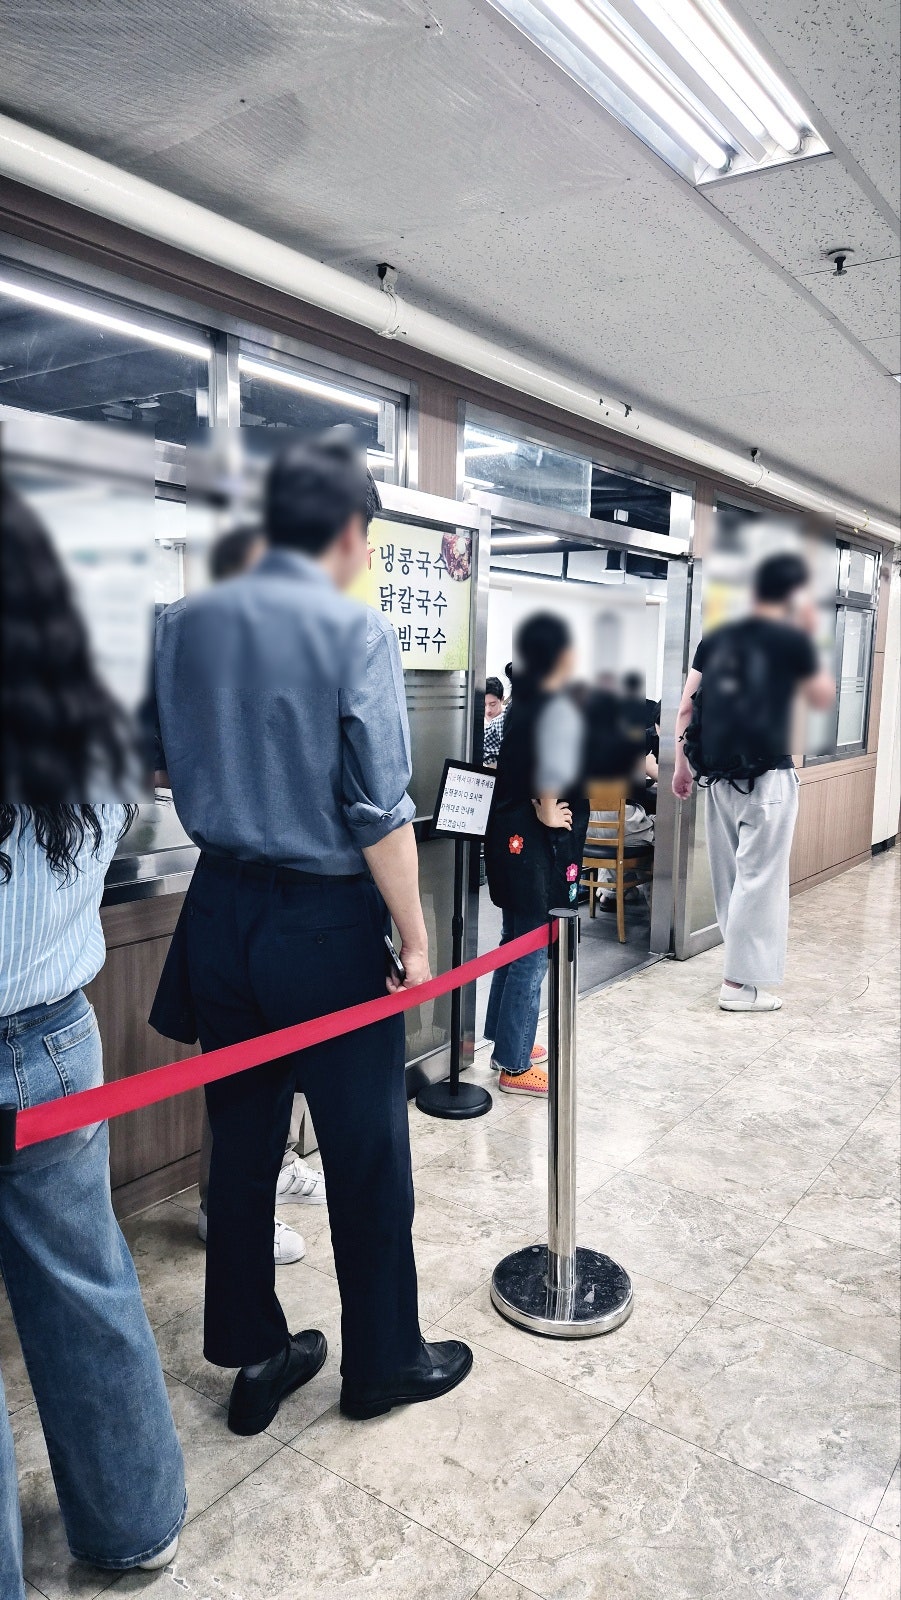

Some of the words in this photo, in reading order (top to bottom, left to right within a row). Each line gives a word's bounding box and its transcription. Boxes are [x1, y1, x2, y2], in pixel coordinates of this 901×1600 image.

[380, 543, 448, 580] 냉콩국수
[379, 583, 448, 618] 닭칼국수
[393, 623, 447, 654] 빔국수
